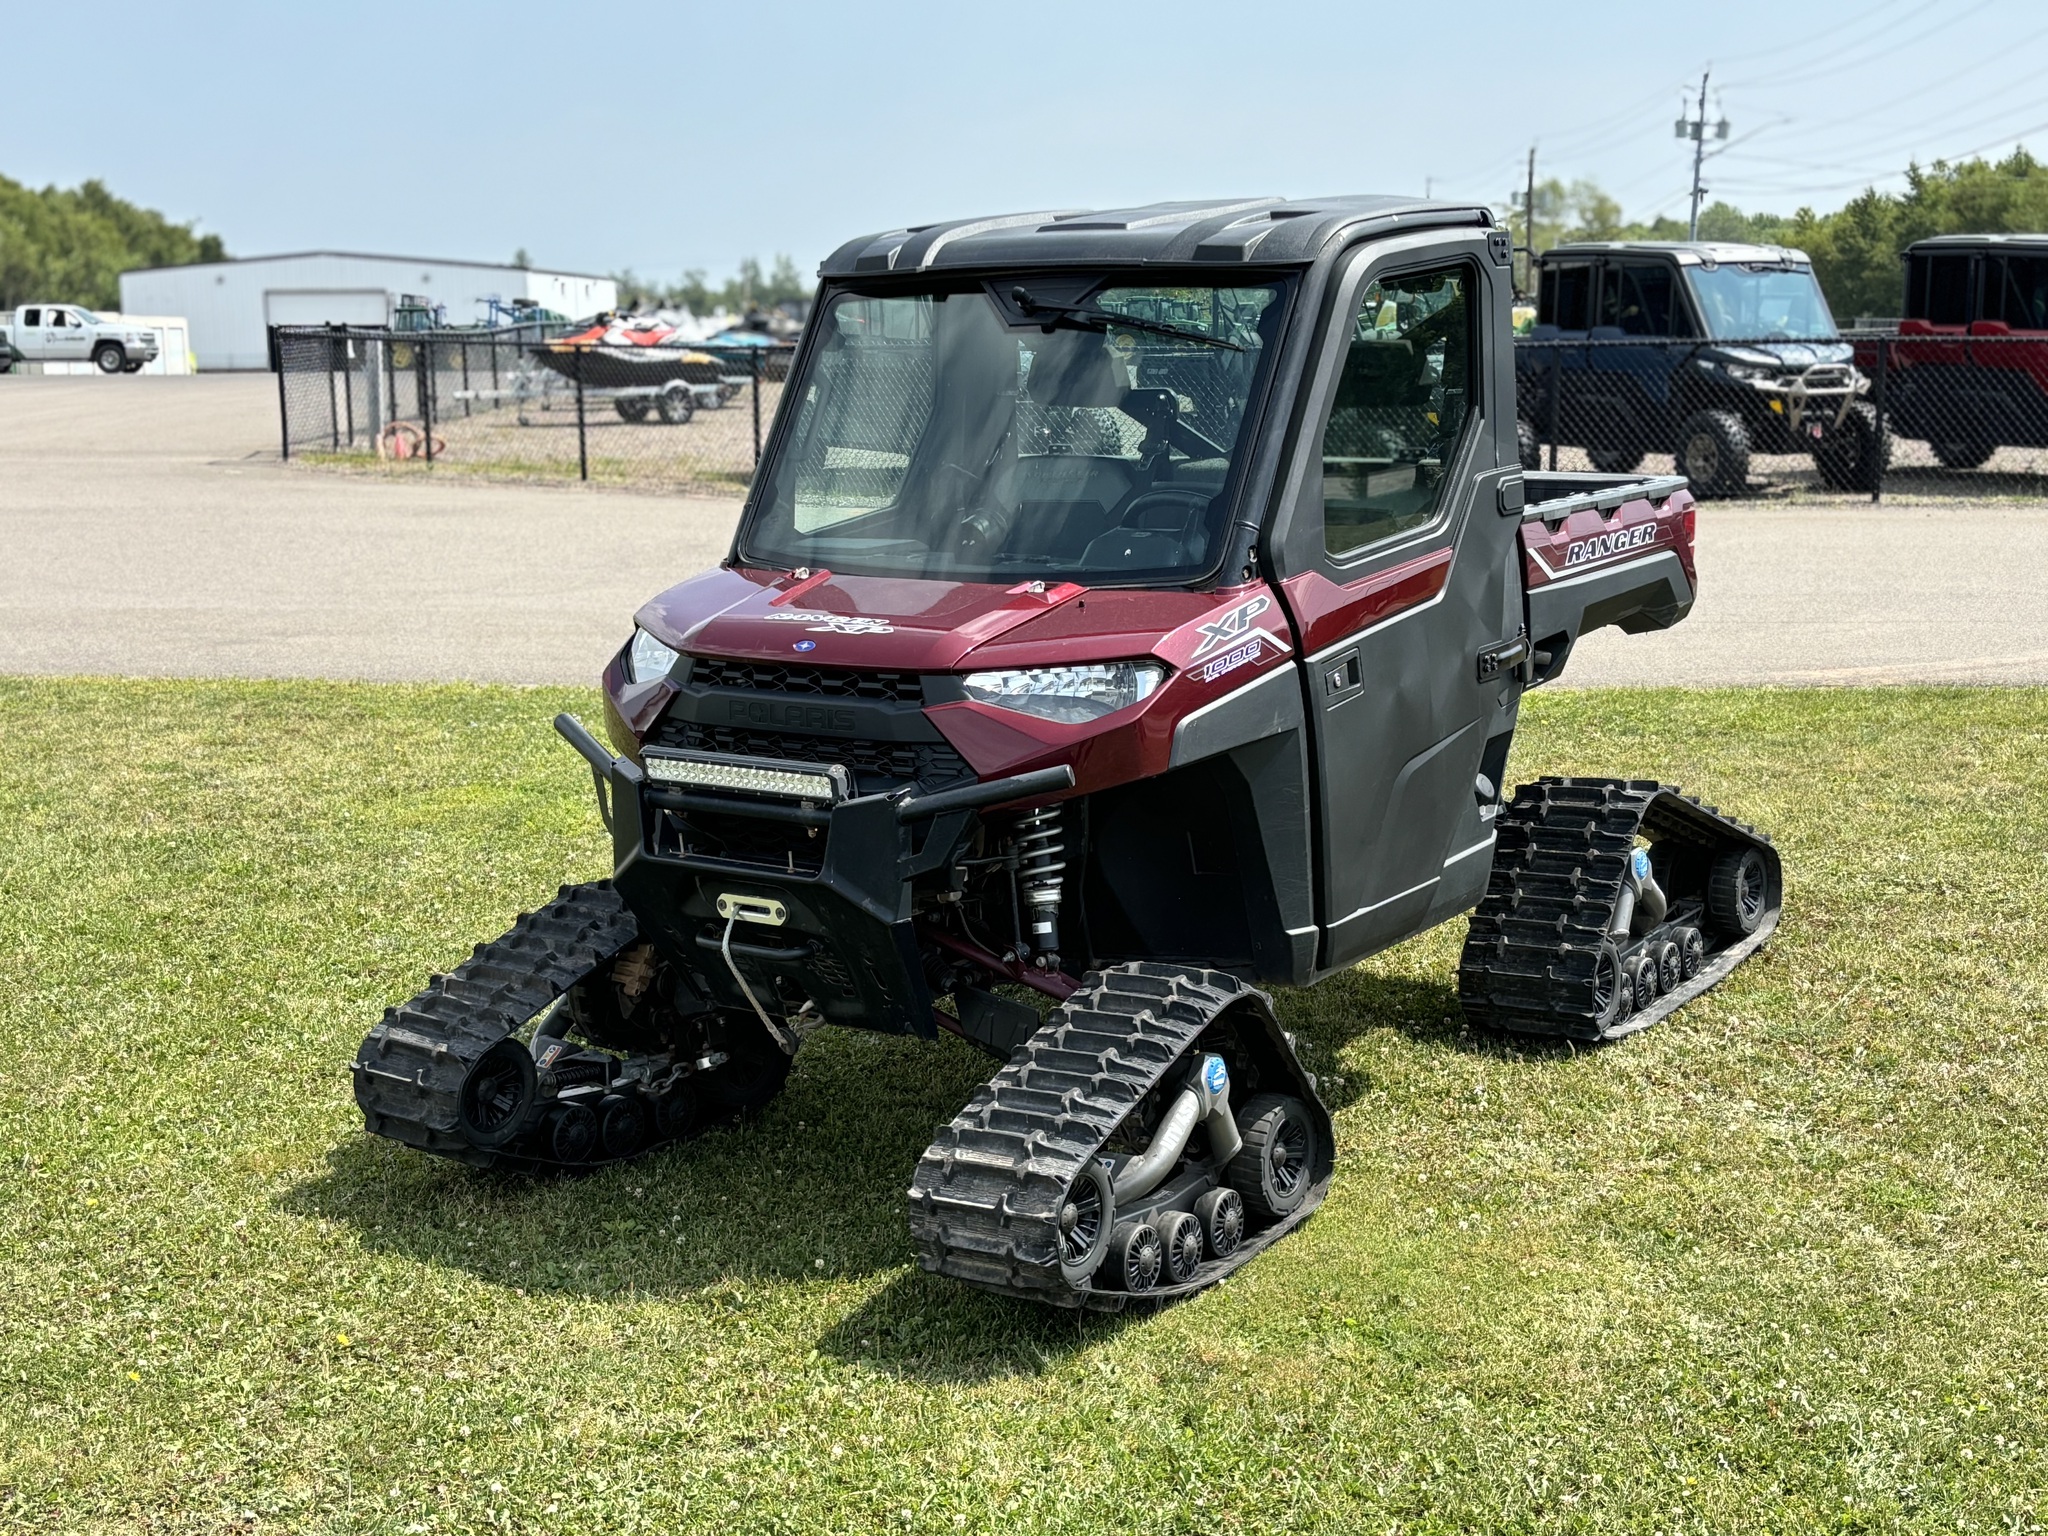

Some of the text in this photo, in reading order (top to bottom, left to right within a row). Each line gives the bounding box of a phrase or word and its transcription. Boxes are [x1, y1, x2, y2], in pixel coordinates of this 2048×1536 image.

[1565, 522, 1657, 566] RANGER
[1191, 594, 1271, 659] XP
[1203, 638, 1262, 679] 1000
[729, 700, 856, 731] POLARIS
